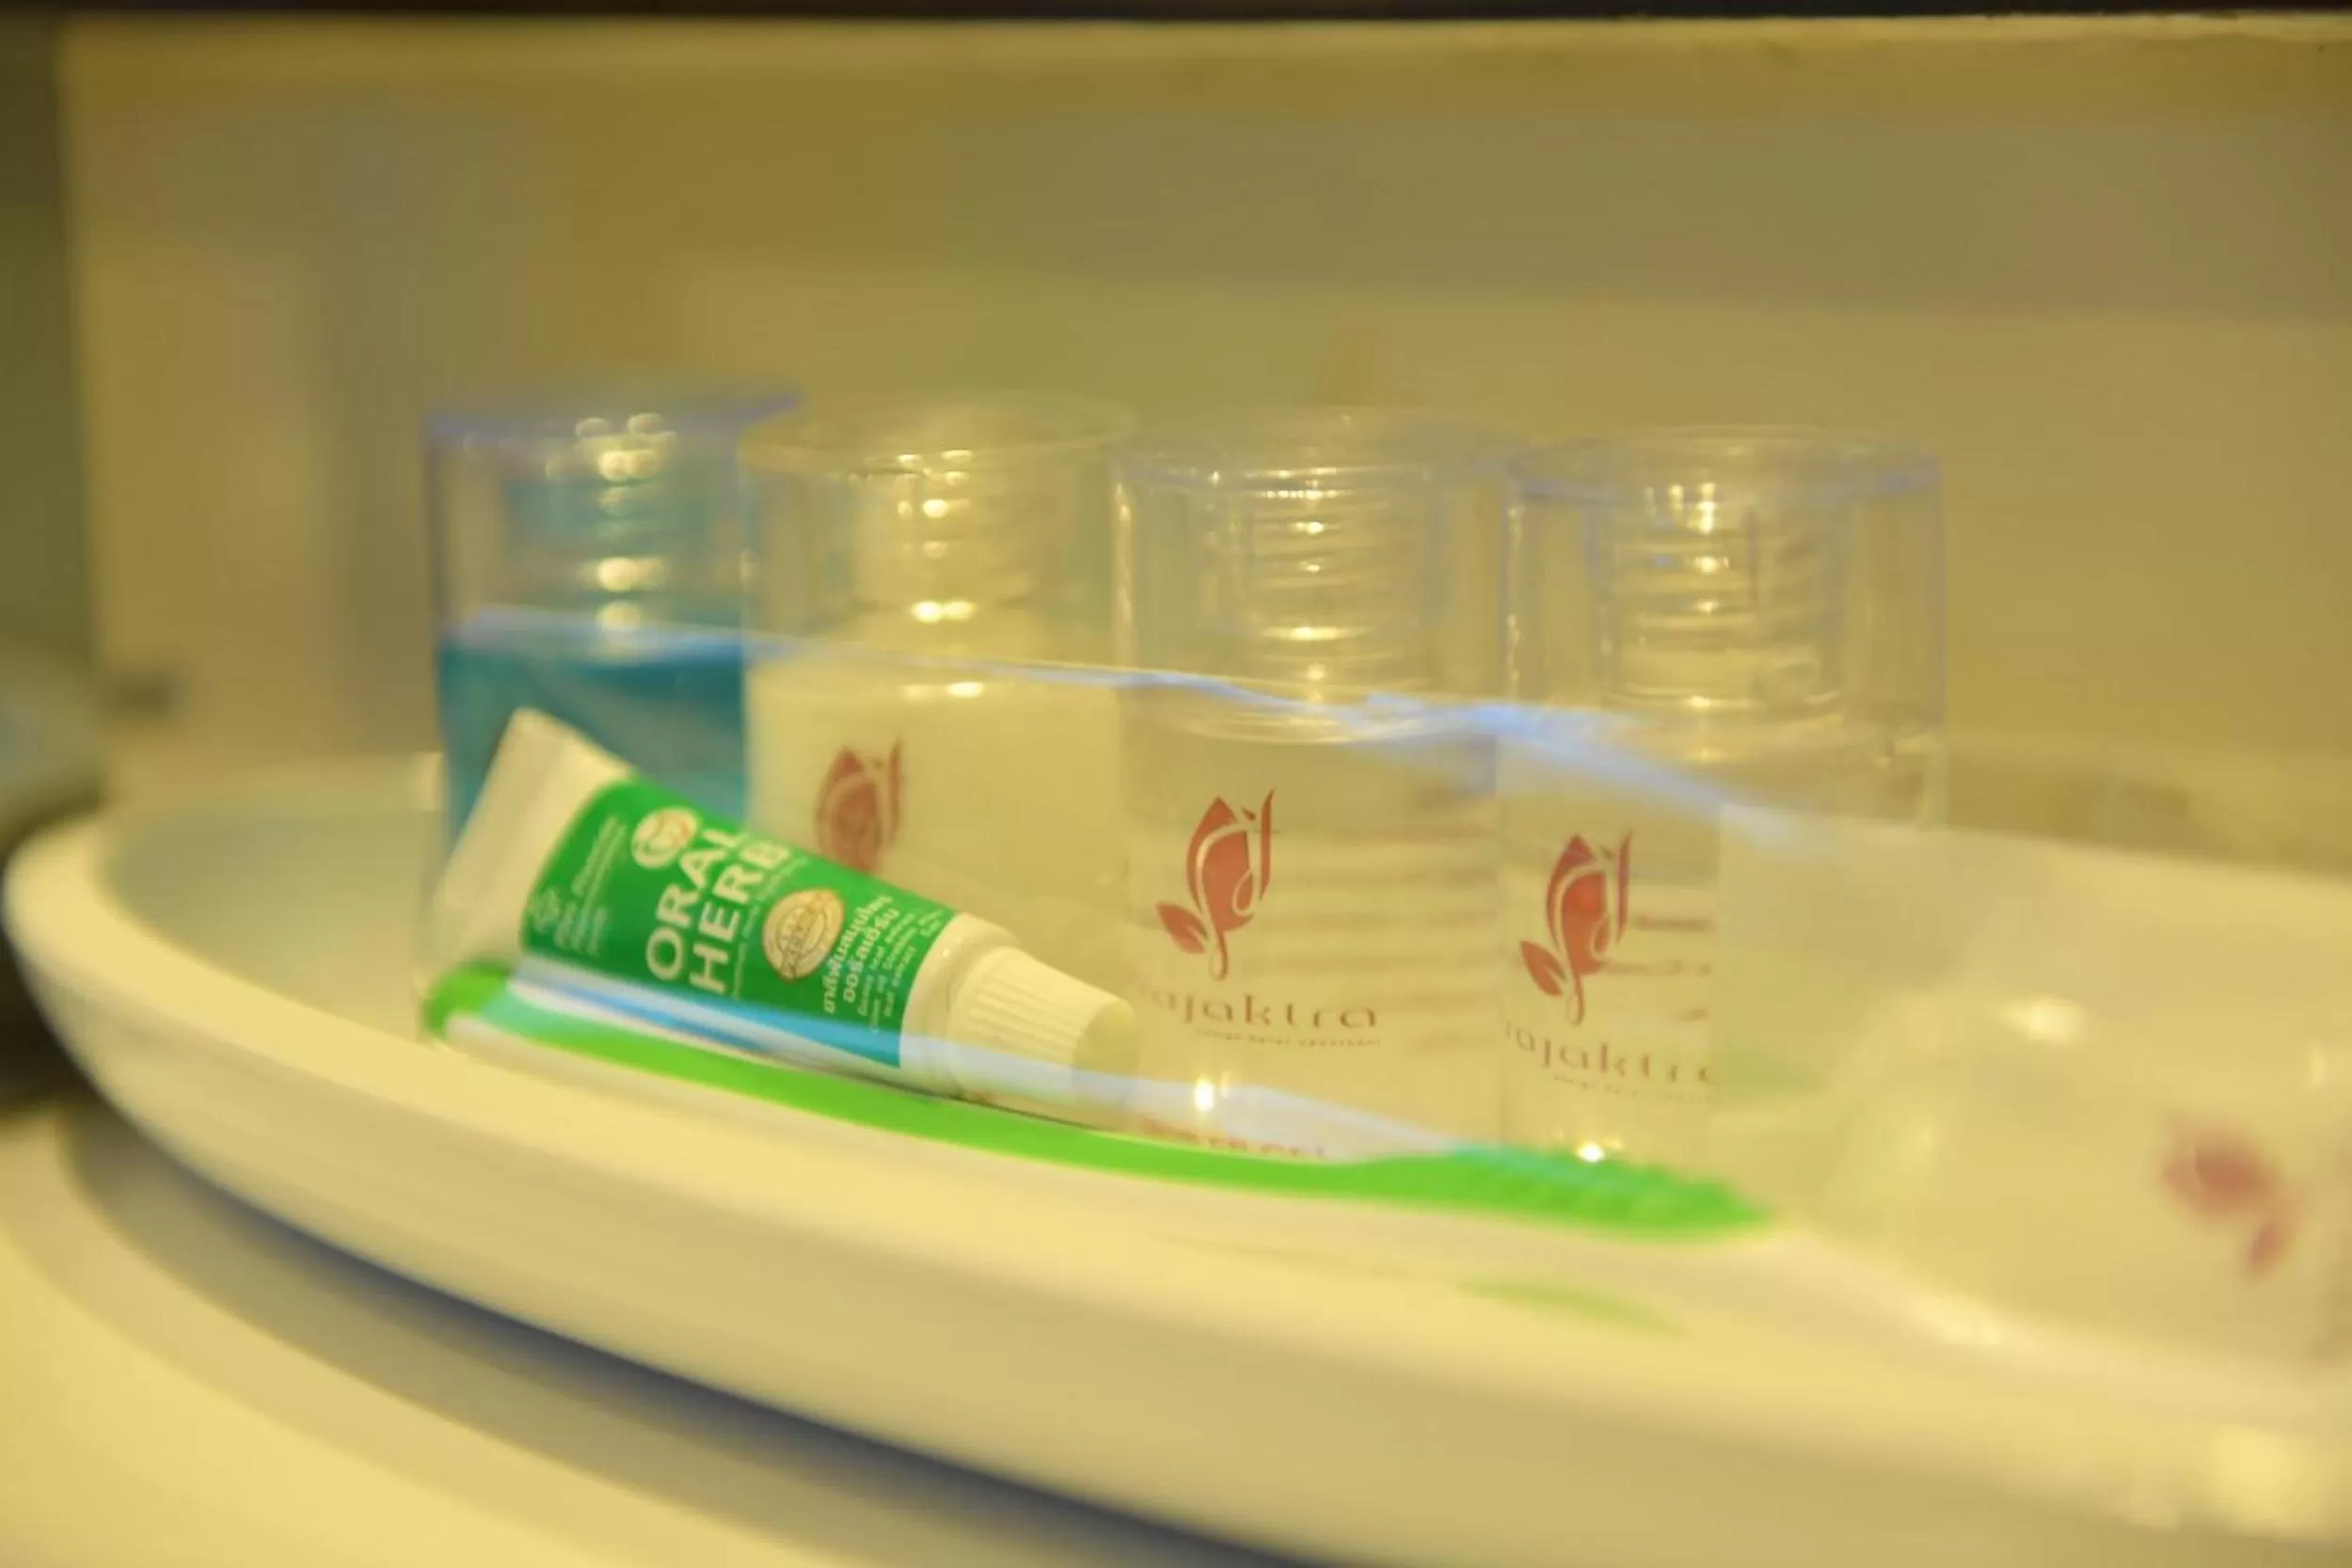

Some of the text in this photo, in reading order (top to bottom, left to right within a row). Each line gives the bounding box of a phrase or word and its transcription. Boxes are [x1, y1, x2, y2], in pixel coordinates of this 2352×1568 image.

[645, 828, 751, 980] ORAL
[688, 842, 790, 996] HERB
[1136, 983, 1376, 1029] ajaktra
